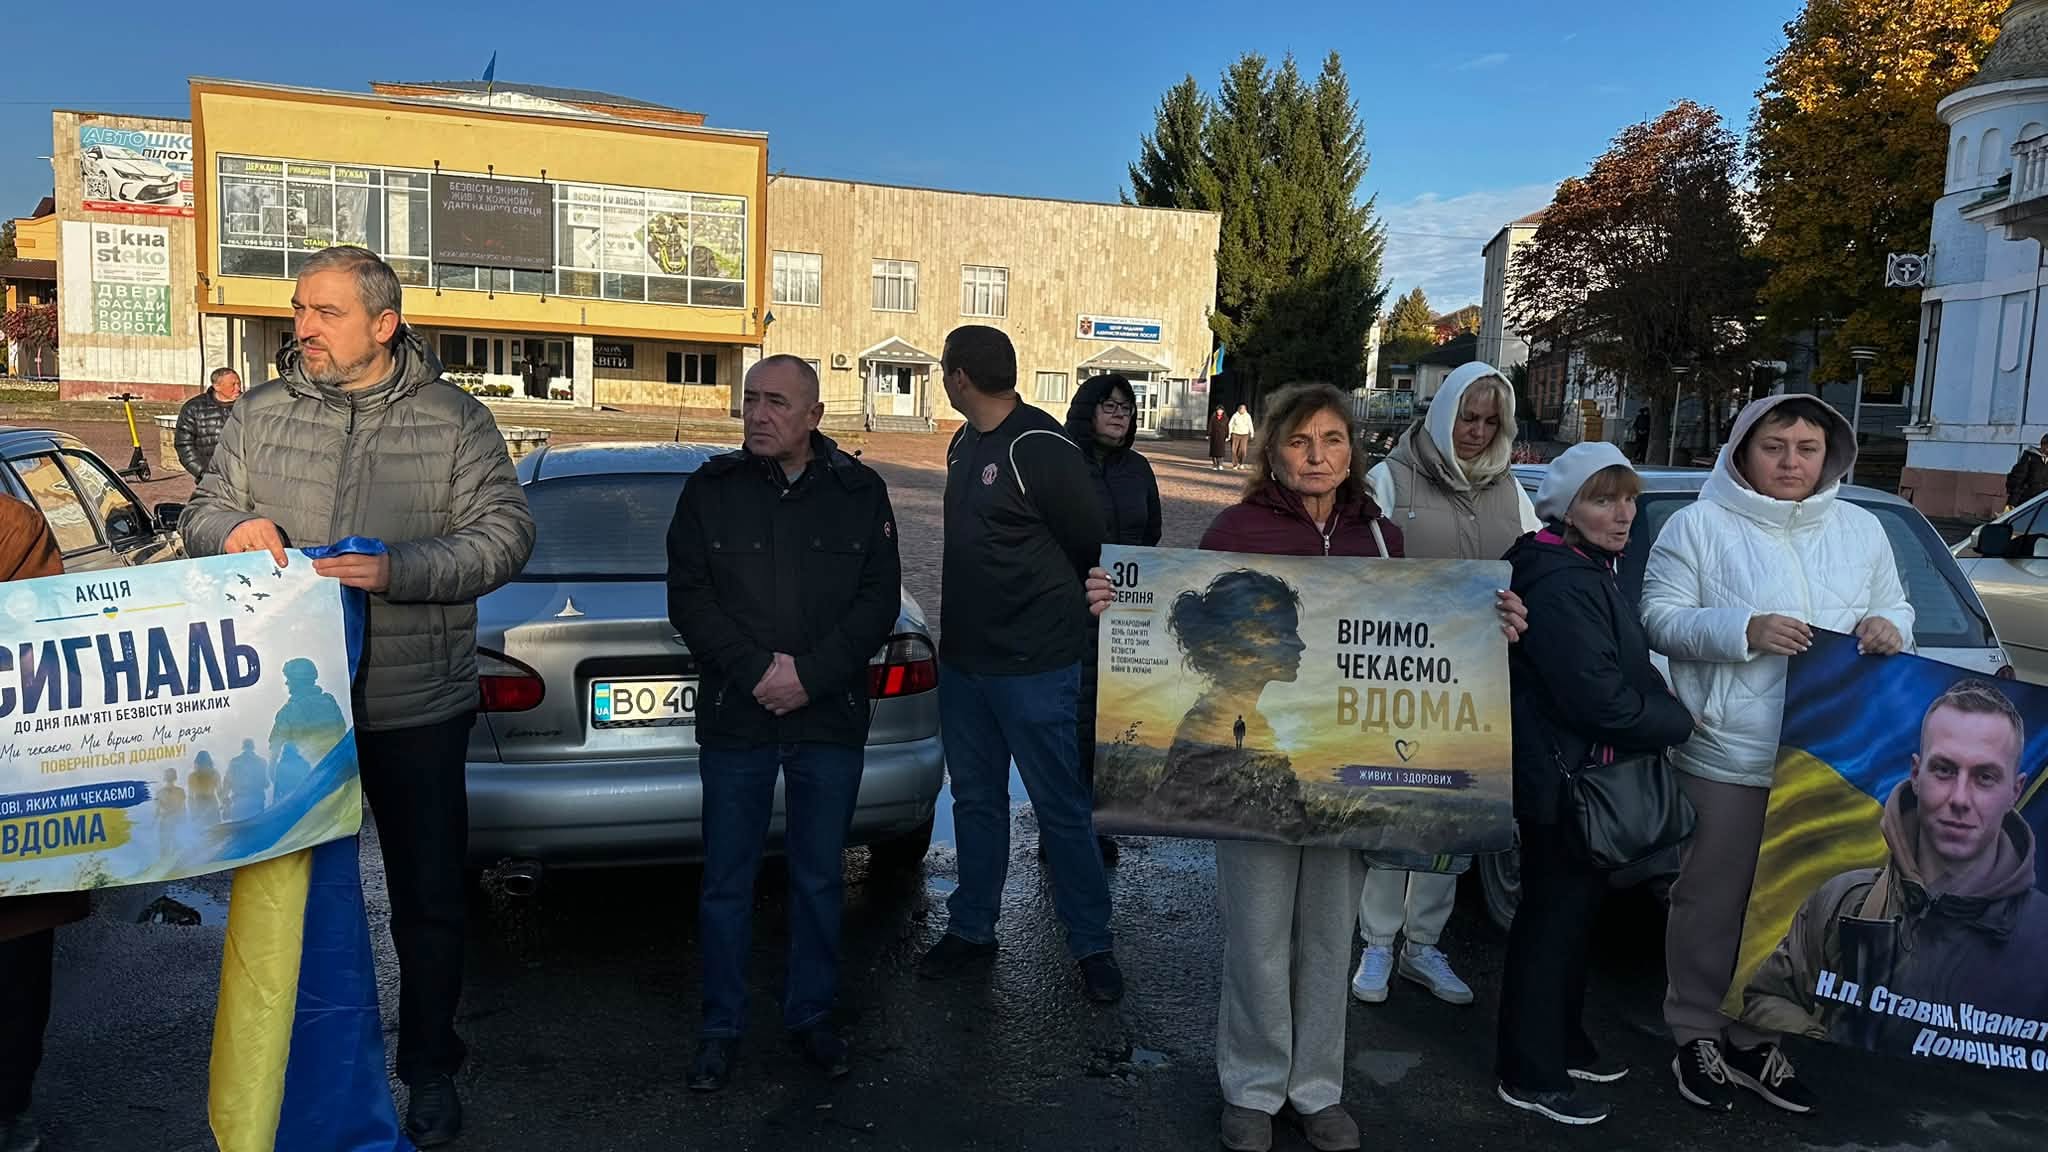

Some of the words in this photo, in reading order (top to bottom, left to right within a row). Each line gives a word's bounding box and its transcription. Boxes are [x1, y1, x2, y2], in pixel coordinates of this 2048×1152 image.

[142, 148, 188, 161] ПІЛОТ
[449, 182, 493, 193] БЕЗВІСТИ
[486, 195, 533, 206] КОЖНОМУ
[512, 206, 542, 217] СЕРЦЯ
[98, 284, 165, 299] ДВЕРІ
[98, 299, 166, 312] ФАСАДИ
[99, 310, 166, 323] РОЛЕТИ
[99, 321, 167, 333] ВОРОТА
[1112, 562, 1139, 588] 30
[75, 580, 132, 603] АКЦІЯ
[1112, 591, 1153, 604] СЕРПНЯ
[1337, 619, 1435, 649] ВІРИМО.
[1337, 653, 1458, 684] ЧЕКАЄМО.
[596, 706, 609, 716] UA
[612, 687, 656, 715] BO
[662, 686, 697, 713] 40
[1337, 686, 1491, 733] ВДОМА.
[14, 721, 31, 735] ДО
[35, 717, 60, 733] ДНЯ
[64, 710, 112, 728] ПАМ'ЯТІ
[116, 703, 172, 721] БЕЗВІСТИ
[176, 696, 231, 714] ЗНИКЛИХ
[0, 743, 21, 763] Ми
[80, 734, 100, 753] Ми
[153, 725, 172, 744] Ми
[41, 752, 126, 775] ПОВЕРНІТЬСЯ
[129, 744, 187, 765] ДОДОМУ!
[1359, 770, 1393, 781] ЖИВИХ
[1402, 772, 1452, 785] ЗДОРОВИХ
[0, 800, 23, 816] ОВІ,
[26, 796, 57, 812] ЯКИХ
[60, 794, 79, 809] МИ
[81, 785, 135, 804] ЧЕКАЄМО
[2, 813, 107, 857] ВДОМА
[1815, 969, 1862, 1007] Н.п.
[1869, 985, 1958, 1032] Ставки,
[1959, 1002, 2048, 1042] Крамат
[1911, 1027, 2028, 1069] Донецька
[2031, 1053, 2048, 1072] о
